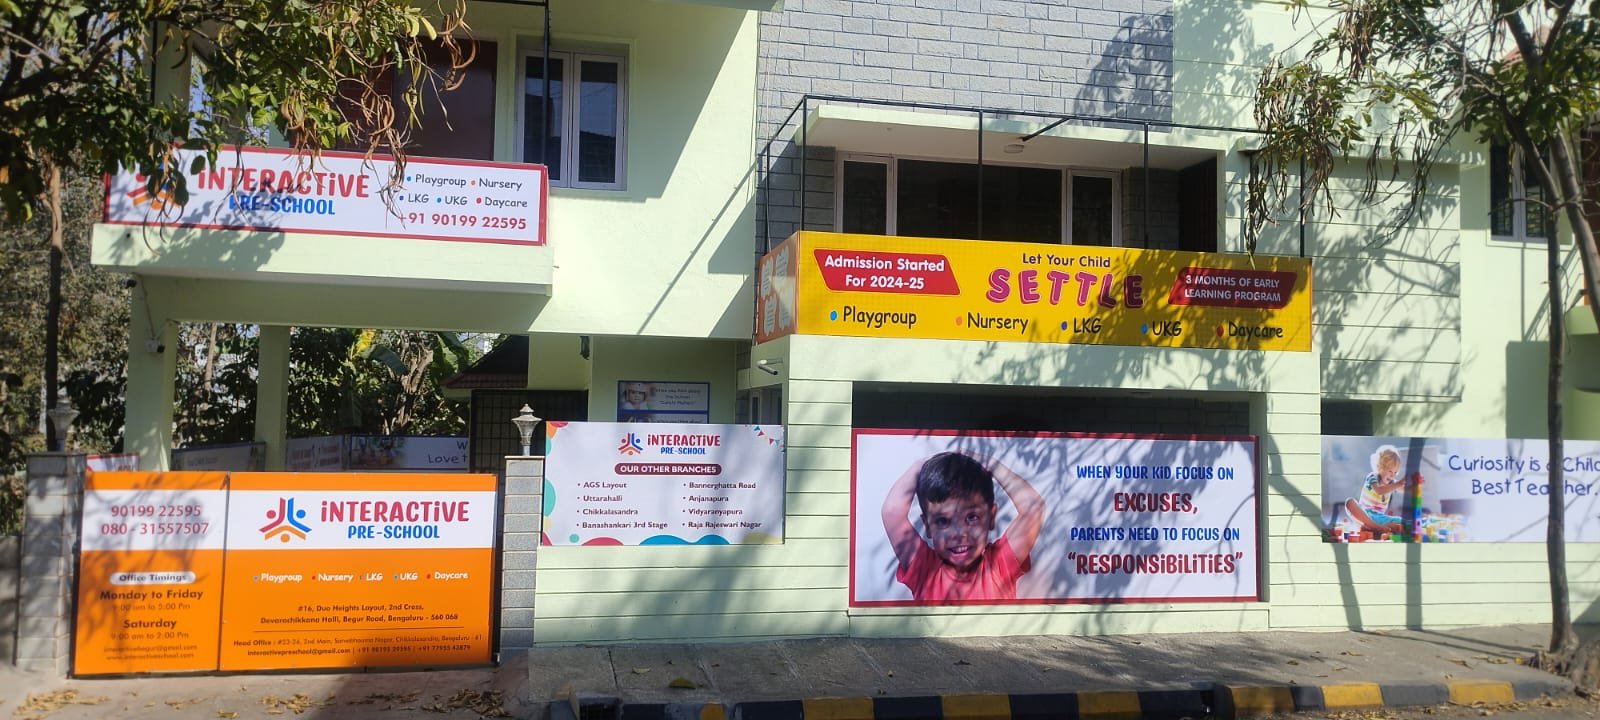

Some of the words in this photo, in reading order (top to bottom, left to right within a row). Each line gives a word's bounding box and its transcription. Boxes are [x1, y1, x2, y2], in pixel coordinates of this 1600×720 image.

[415, 174, 466, 188] Playgroup
[479, 178, 522, 191] Nursery
[228, 195, 335, 215] PRE-SCHOOL
[408, 194, 430, 203] LKG
[444, 196, 468, 206] UKG
[484, 197, 528, 208] Daycare
[432, 214, 477, 226] 90199
[482, 216, 526, 230] 22595
[825, 254, 892, 270] Admission
[896, 258, 944, 272] Started
[1022, 253, 1042, 264] Let
[1046, 254, 1074, 266] Your
[1079, 256, 1111, 268] Child
[845, 274, 866, 288] For
[870, 275, 924, 290] 2024-25
[986, 268, 1144, 308] SETTLE
[1185, 275, 1192, 284] 3
[1194, 275, 1236, 286] MONTHS
[1238, 277, 1251, 287] OF
[1254, 278, 1280, 288] EARLY
[1184, 288, 1232, 300] LEARNING
[1235, 291, 1281, 302] PROGRAM
[843, 306, 916, 329] Playgroup
[968, 312, 1028, 334] Nursery
[1074, 318, 1101, 334] LKG
[1152, 320, 1182, 337] UKG
[1228, 321, 1284, 341] Daycare
[660, 446, 706, 454] PRE-SCHOOL
[428, 454, 460, 464] Love
[1448, 455, 1524, 474] Curiosity
[1530, 456, 1540, 472] is
[1076, 465, 1110, 479] WHEN
[1175, 466, 1214, 480] FOCUS
[1218, 467, 1234, 480] ON
[602, 482, 627, 490] Layout
[689, 482, 736, 490] Bannerghatta
[1472, 479, 1511, 495] Best
[1515, 478, 1598, 496] Teaher.
[1114, 492, 1198, 514] EXCUSES,
[111, 505, 154, 518] 90199
[159, 504, 202, 517] 22595
[688, 508, 742, 516] Vidyaranyapura
[101, 522, 128, 536] 080
[140, 522, 209, 535] 31557507
[348, 524, 440, 539] PRE-SCHOOL
[648, 522, 668, 530] Stage
[740, 522, 762, 530] Nagar
[1070, 527, 1124, 541] PARENTS
[1128, 527, 1158, 541] NEED
[1163, 528, 1178, 541] TO
[1182, 528, 1220, 541] FOCUS
[1224, 528, 1240, 541] ON
[119, 574, 146, 582] Office
[150, 574, 187, 583] Timings
[260, 572, 302, 584] Playgroup
[318, 573, 354, 583] Nursery
[366, 573, 384, 582] LKG
[400, 572, 418, 581] UKG
[434, 572, 468, 580] Daycare
[100, 590, 148, 601] Monday
[152, 591, 162, 600] to
[166, 589, 204, 600] Friday
[333, 604, 360, 613] Heights
[124, 618, 176, 630] Saturday
[342, 616, 364, 624] Begur
[365, 615, 386, 623] Road,
[388, 614, 424, 622] Bengaluru
